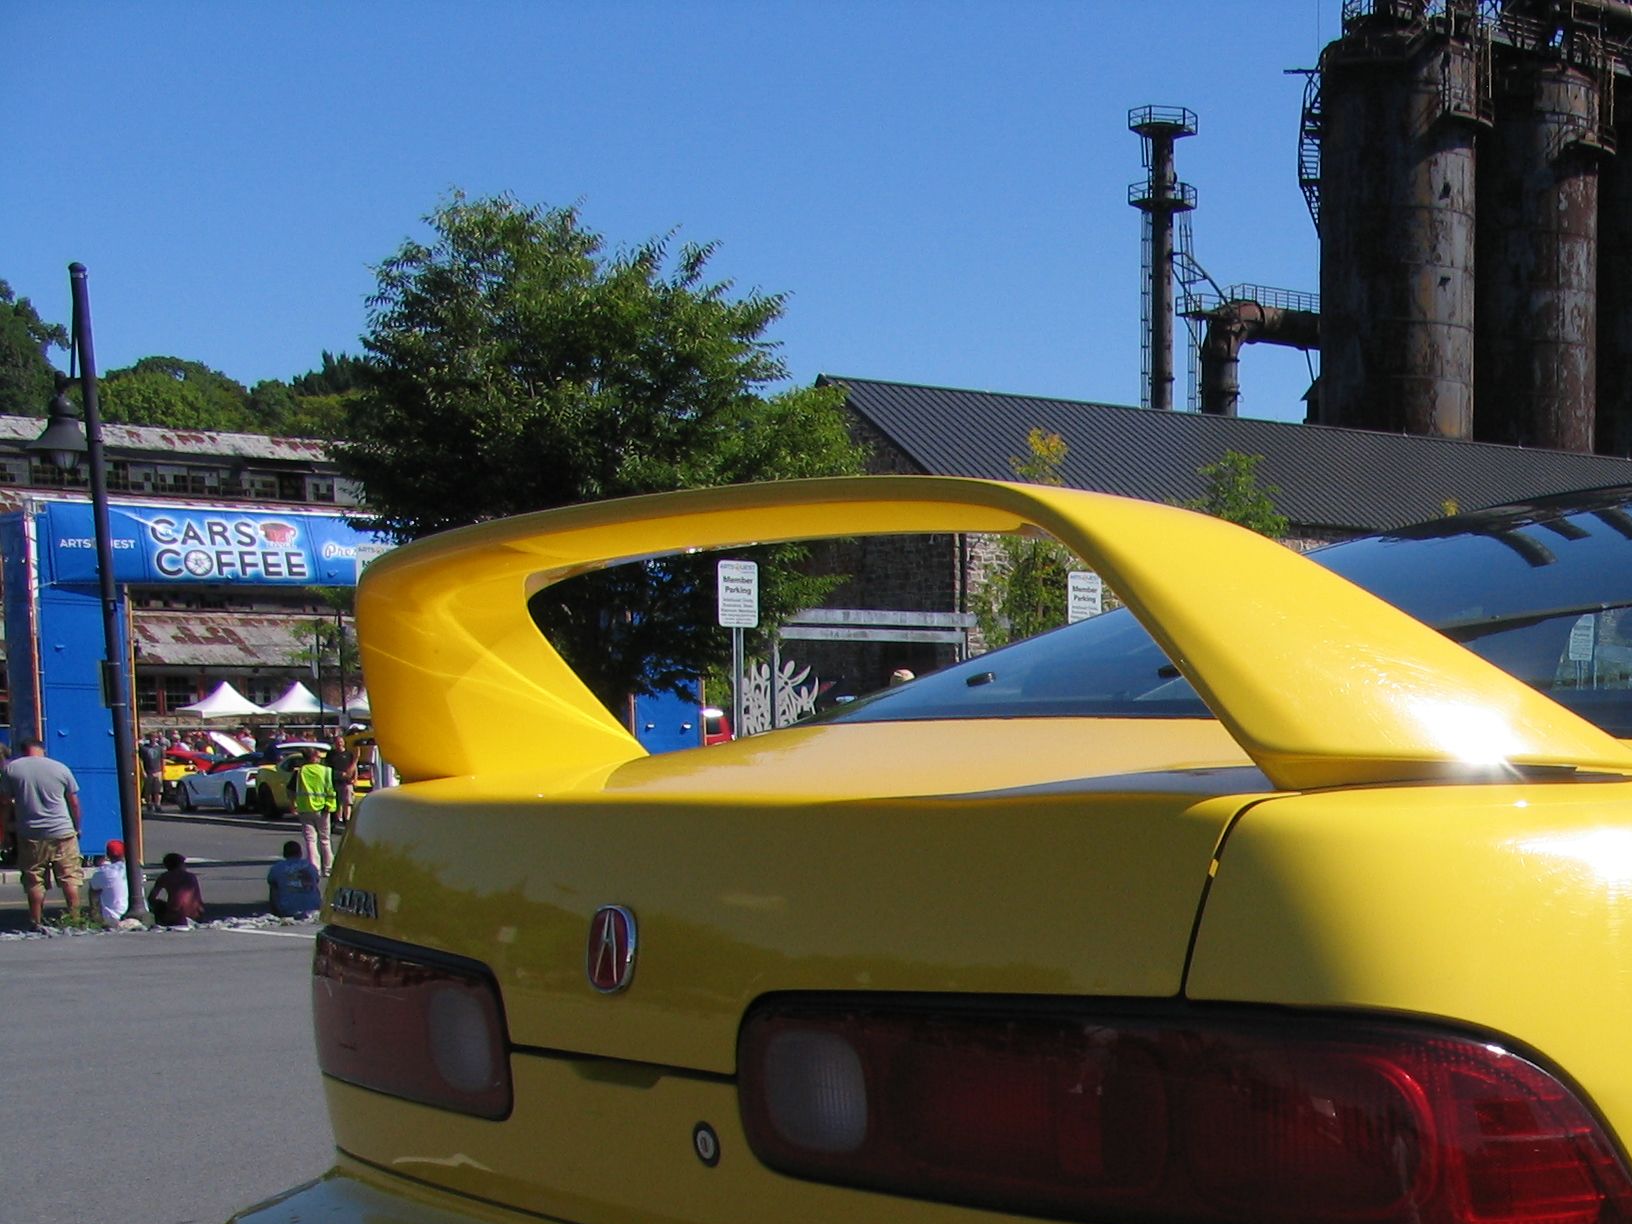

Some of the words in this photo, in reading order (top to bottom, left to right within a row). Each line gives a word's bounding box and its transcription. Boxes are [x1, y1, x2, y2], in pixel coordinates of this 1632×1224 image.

[59, 538, 136, 550] ARTSEST
[150, 518, 259, 547] CARS
[156, 548, 307, 577] COFFEE
